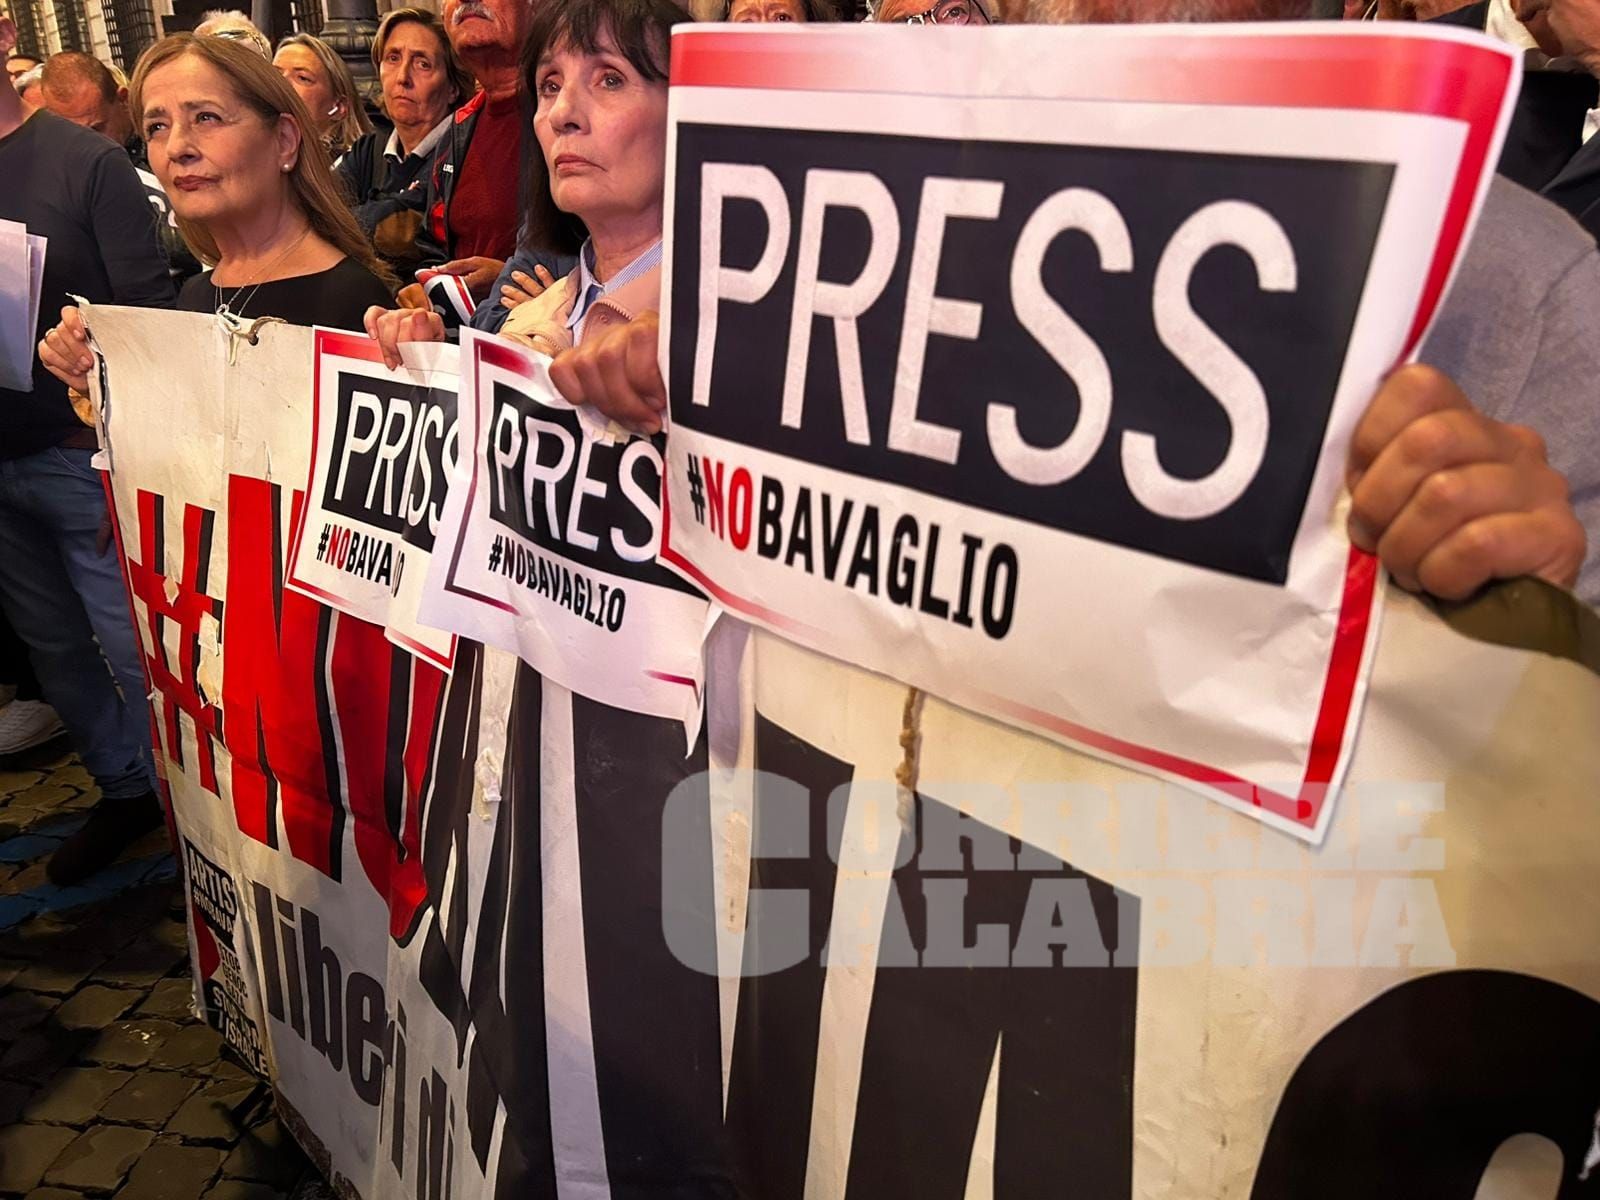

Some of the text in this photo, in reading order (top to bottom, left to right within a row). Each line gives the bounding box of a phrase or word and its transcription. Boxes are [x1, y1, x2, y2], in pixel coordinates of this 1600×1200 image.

[692, 161, 1298, 520] PRESS
[494, 402, 665, 562] PRES
[687, 452, 1019, 639] #NOBAVAGLIO
[488, 534, 626, 632] #NOBAVAGLIO
[189, 846, 236, 916] ARTIS
[193, 884, 234, 934] #NOBAVA
[222, 961, 249, 999] GENOC
[252, 880, 408, 1181] liberi
